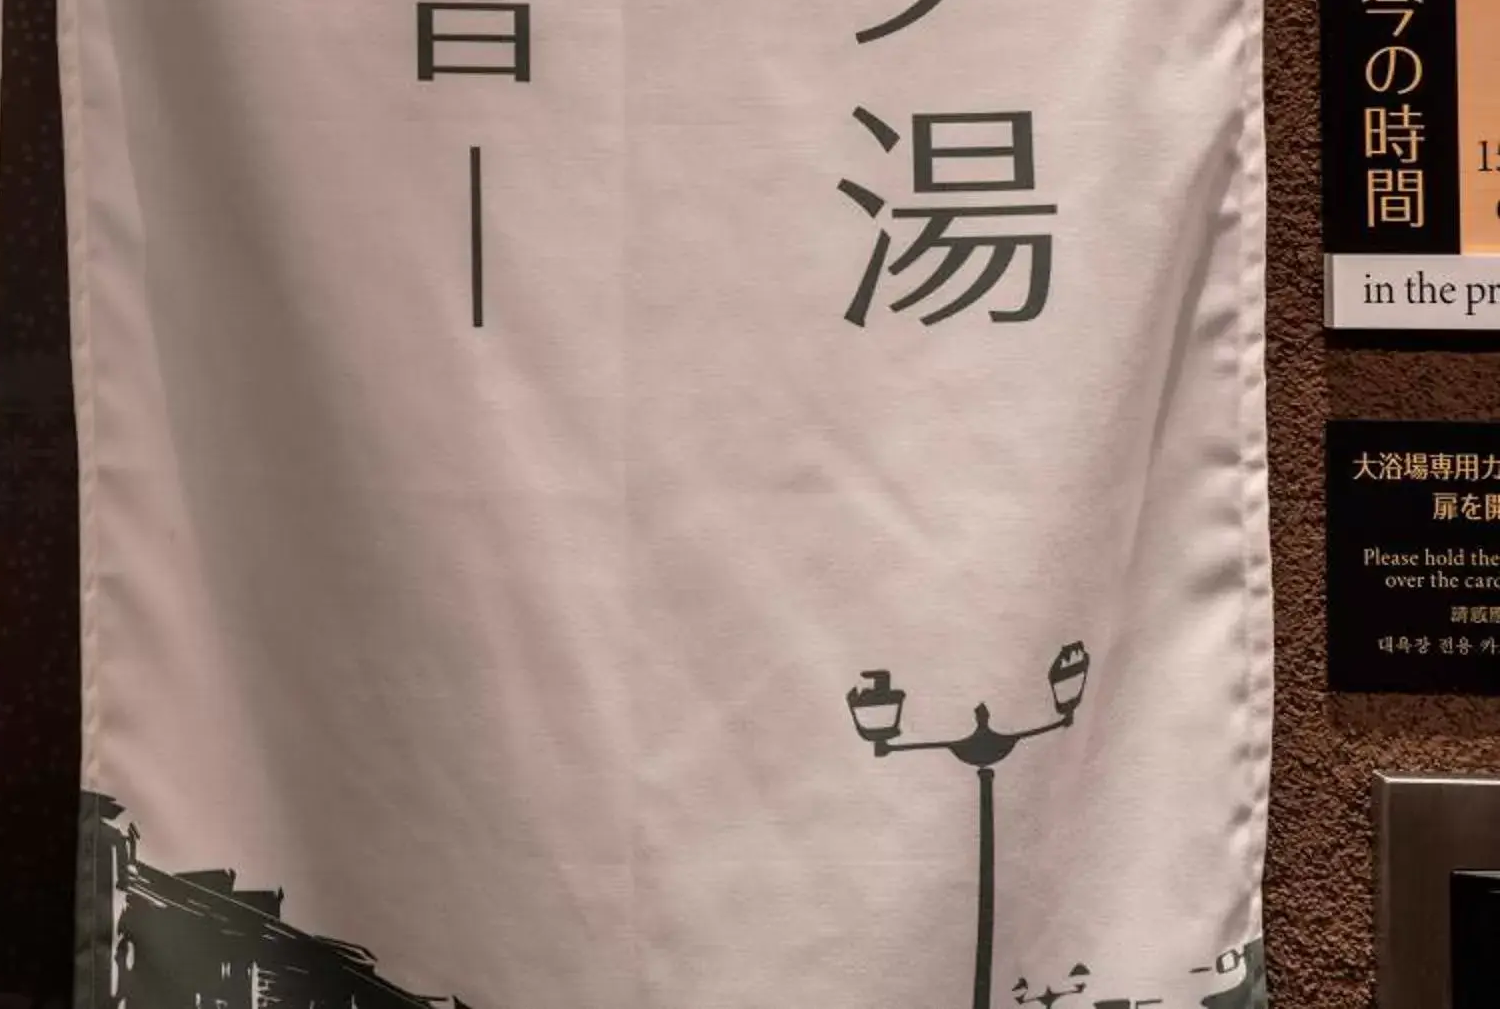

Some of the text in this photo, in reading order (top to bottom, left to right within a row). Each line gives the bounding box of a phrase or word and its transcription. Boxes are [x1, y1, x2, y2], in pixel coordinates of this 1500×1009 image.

[1364, 273, 1396, 304] in
[1405, 270, 1457, 304] the
[1363, 546, 1420, 567] Please
[1424, 547, 1466, 567] hold
[1384, 575, 1426, 589] over
[1429, 570, 1460, 589] the
